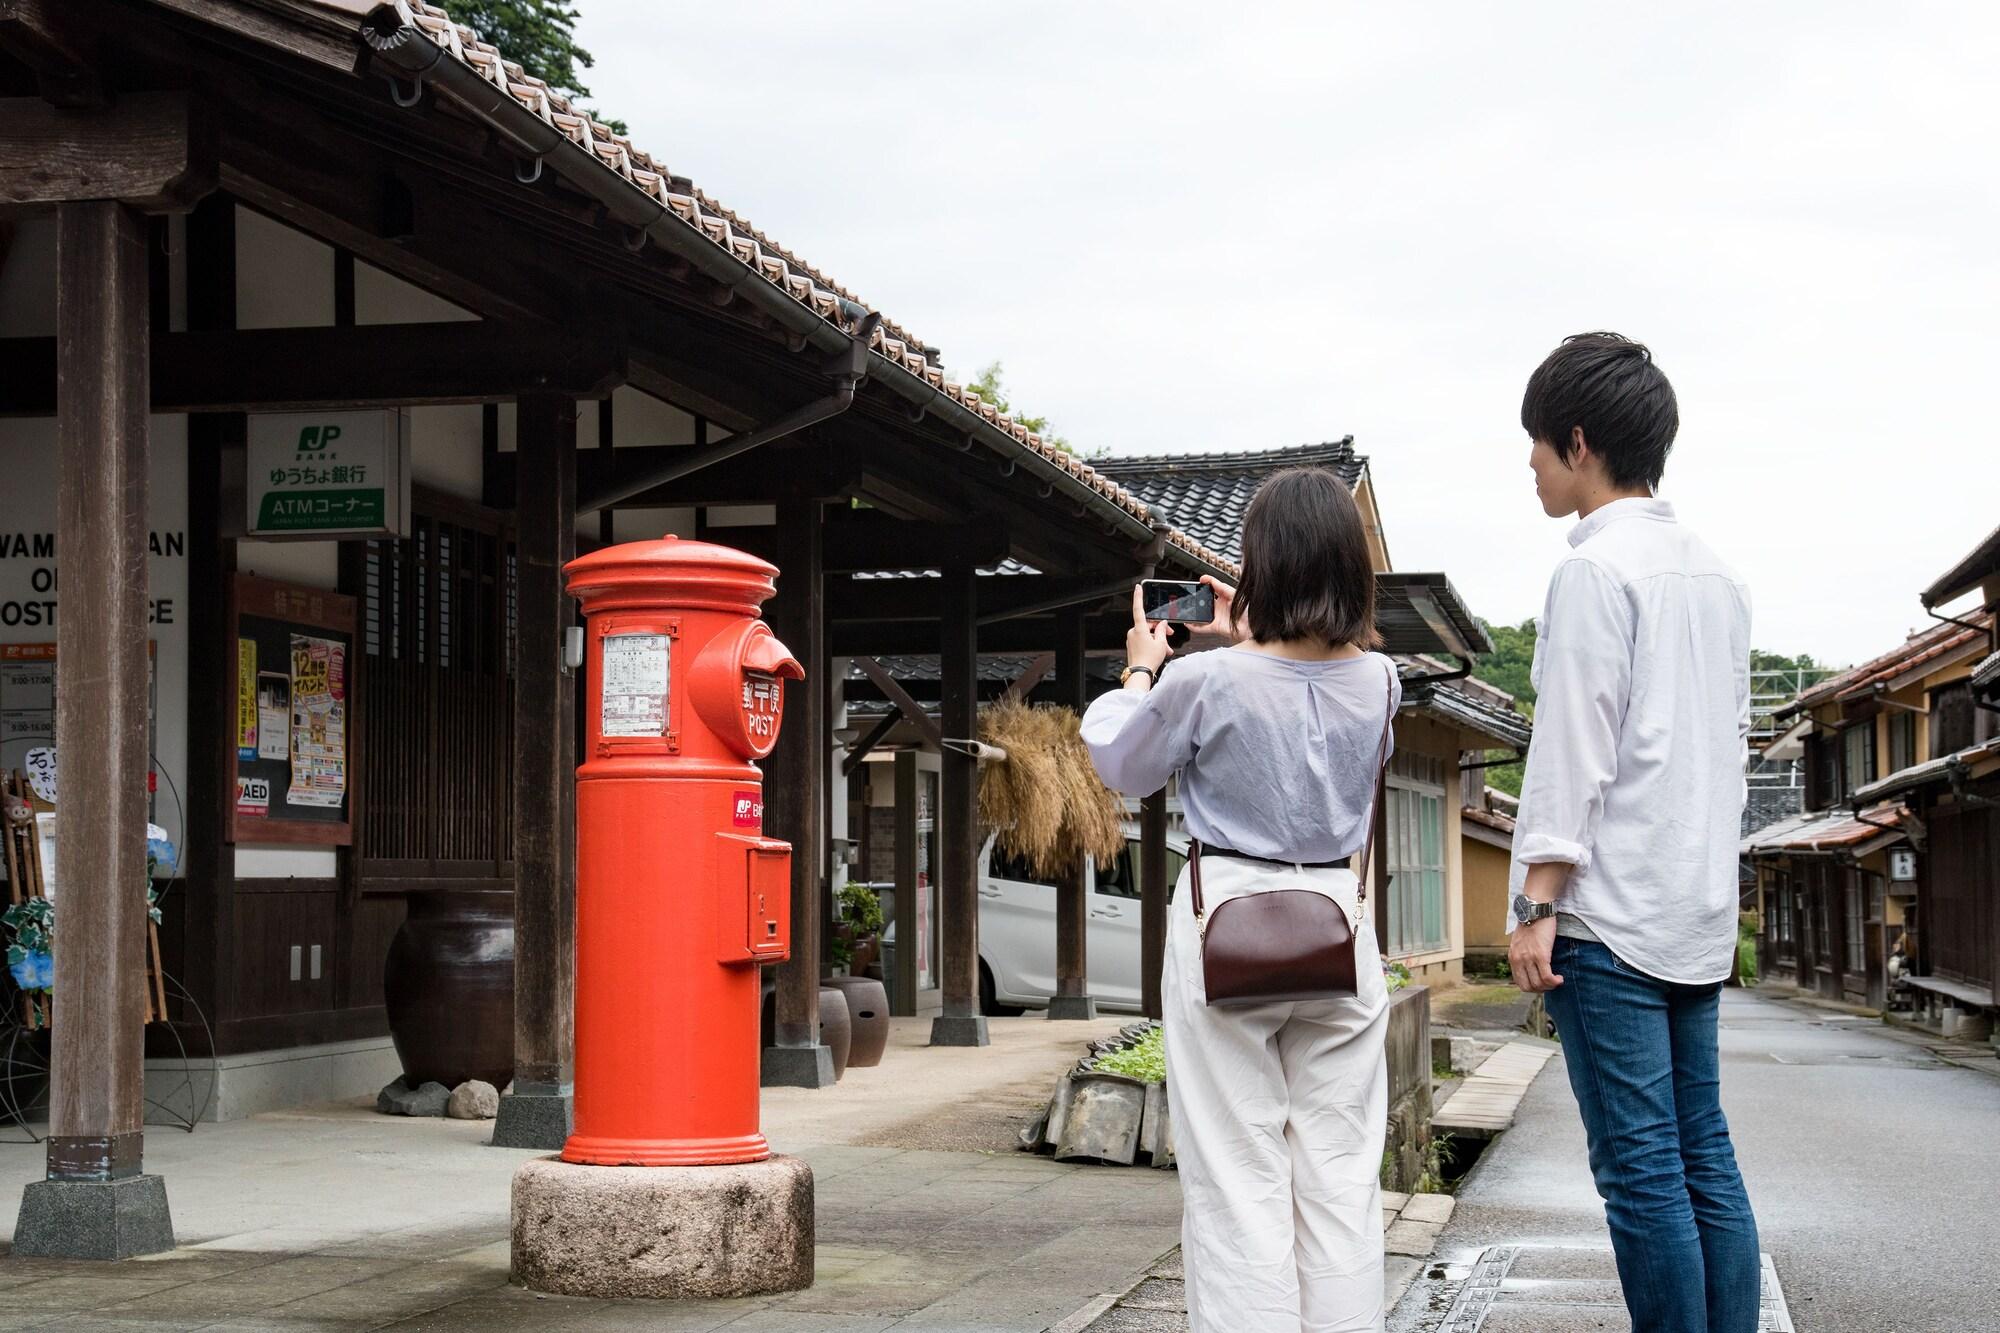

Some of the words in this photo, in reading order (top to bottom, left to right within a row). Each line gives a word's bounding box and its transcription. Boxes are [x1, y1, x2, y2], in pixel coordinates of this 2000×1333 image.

[298, 426, 341, 451] JP
[296, 453, 337, 461] BANK
[271, 465, 366, 486] ゆうちょ銀行
[272, 496, 375, 515] ATMコーナー
[149, 532, 184, 556] AN
[0, 601, 57, 626] OST
[748, 712, 774, 736] POST
[243, 784, 267, 799] AED
[736, 799, 752, 814] JP
